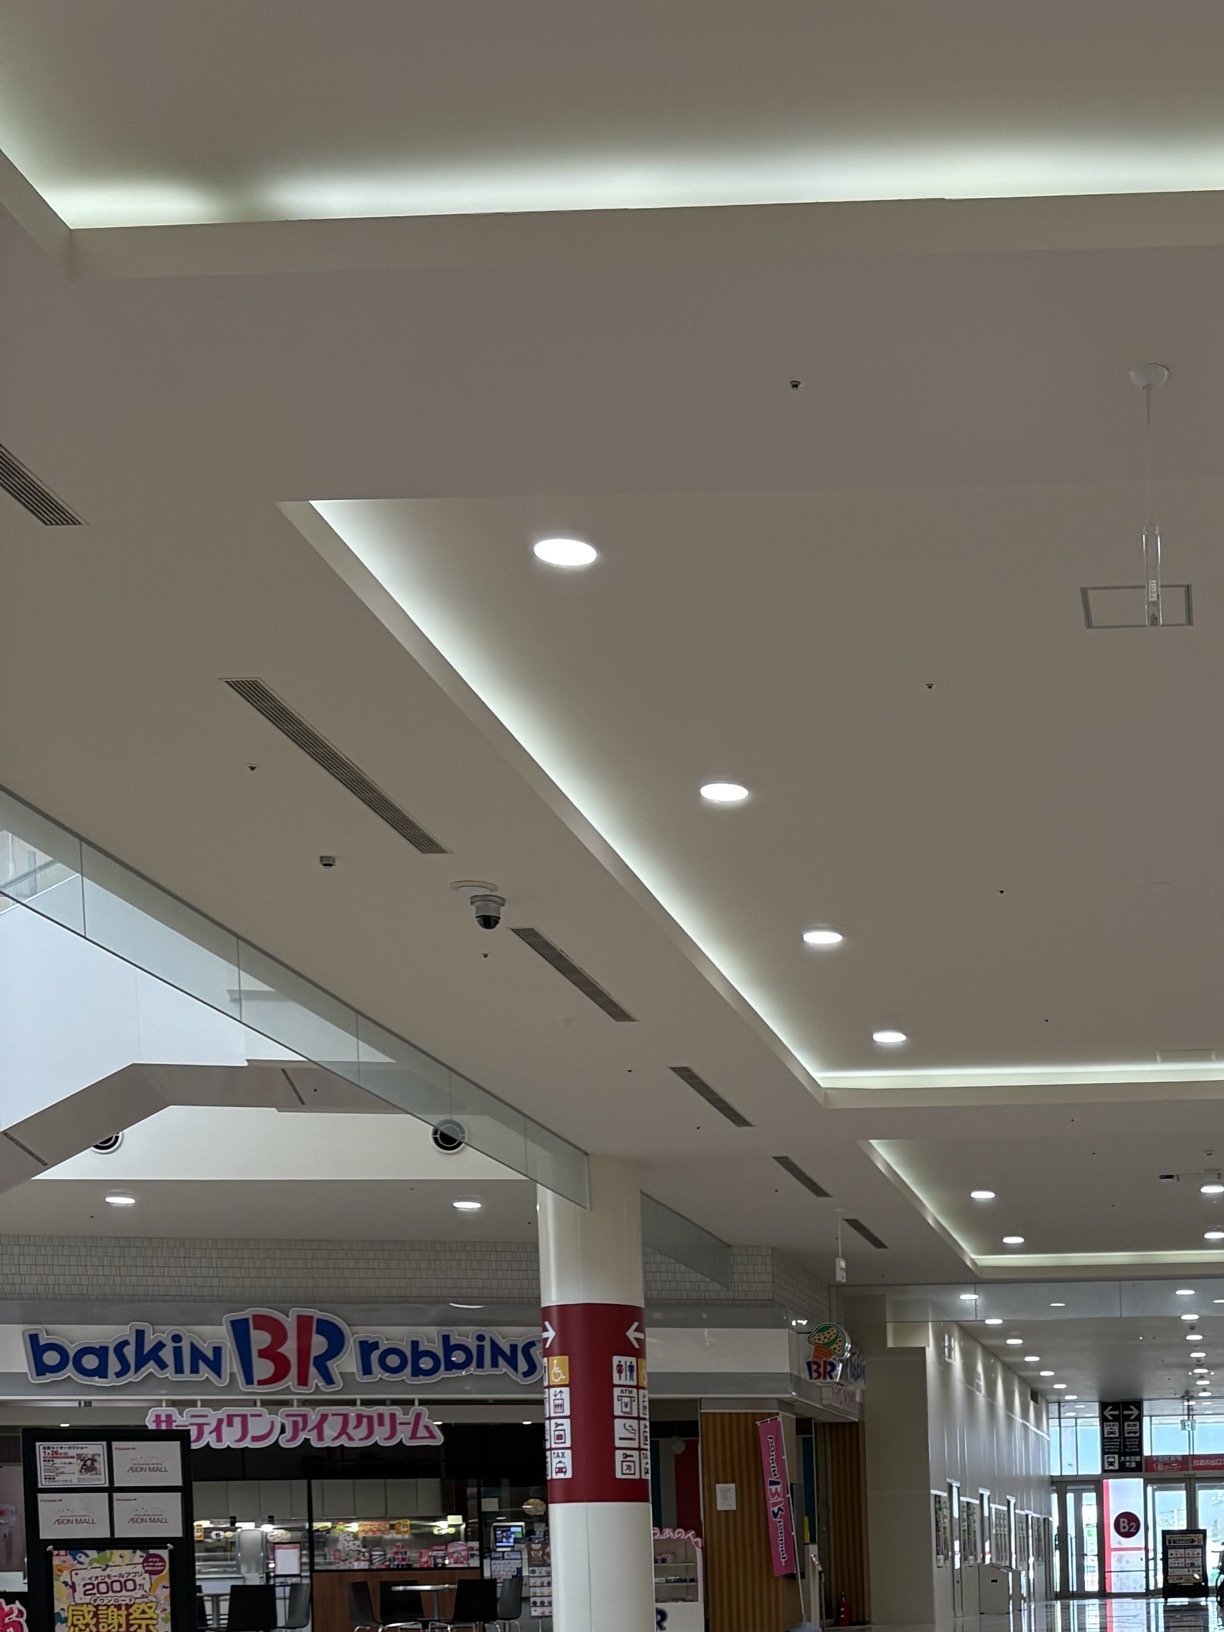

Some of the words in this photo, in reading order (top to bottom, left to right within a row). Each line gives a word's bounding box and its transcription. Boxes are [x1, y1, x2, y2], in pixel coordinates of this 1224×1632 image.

[28, 1329, 222, 1380] baskin
[229, 1314, 346, 1386] BR
[358, 1334, 539, 1379] robbins
[806, 1360, 836, 1380] BR
[152, 1413, 275, 1443] サーティワン
[285, 1413, 438, 1442] アイスクリーム
[1120, 1518, 1137, 1532] B2
